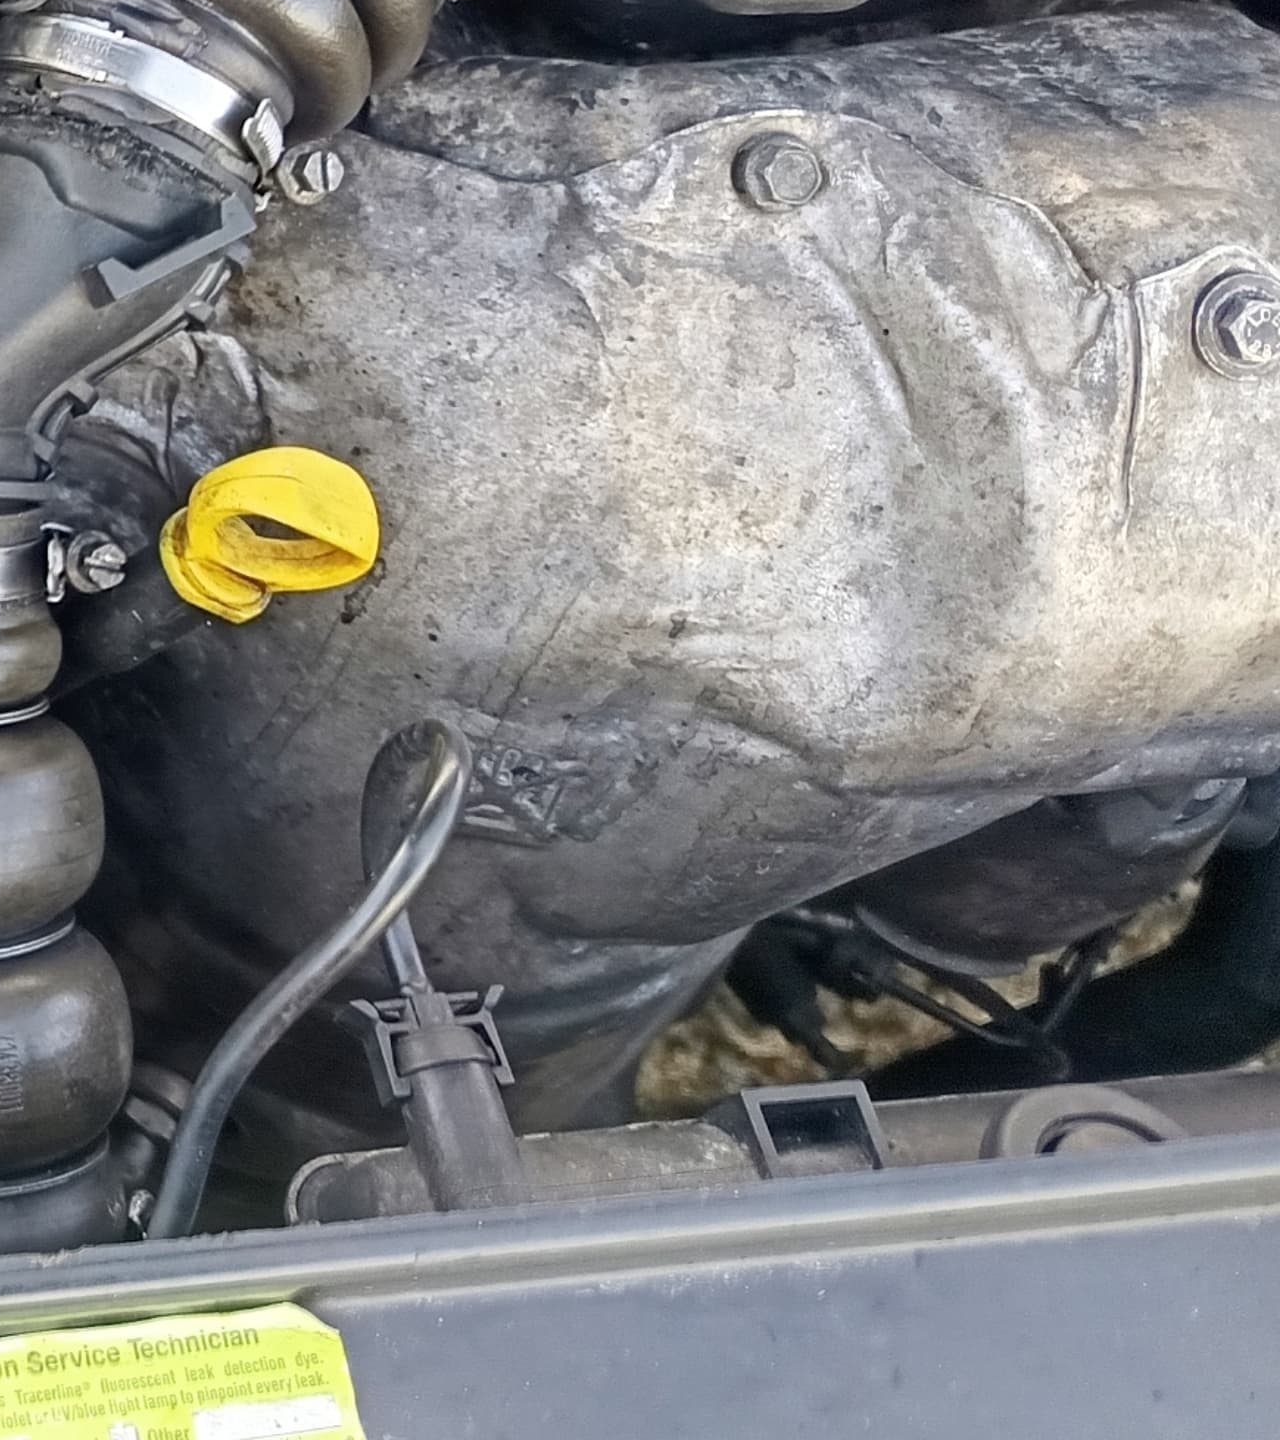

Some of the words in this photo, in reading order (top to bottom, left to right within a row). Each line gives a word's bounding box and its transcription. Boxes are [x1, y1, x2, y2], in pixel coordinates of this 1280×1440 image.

[27, 1344, 121, 1374] Service
[128, 1327, 260, 1361] Technician
[100, 1370, 177, 1394] fluorescent
[185, 1364, 215, 1382] leak
[224, 1355, 286, 1377] detection
[295, 1351, 325, 1369] dye.
[108, 1396, 140, 1416] light
[143, 1391, 178, 1410] lamp
[181, 1389, 194, 1405] to
[197, 1381, 253, 1405] pinpoint
[256, 1377, 292, 1394] every
[295, 1370, 330, 1390] leak.
